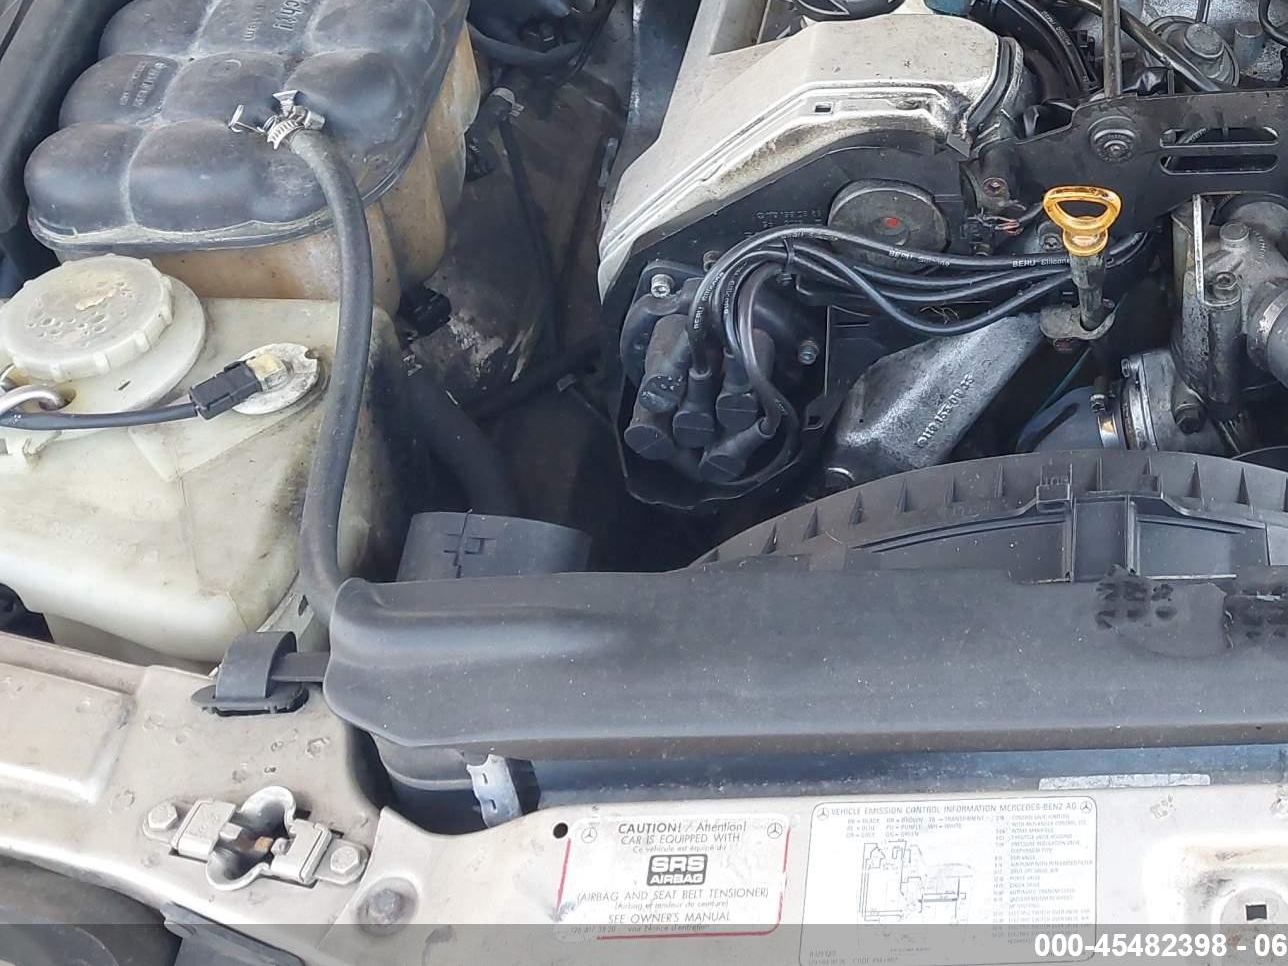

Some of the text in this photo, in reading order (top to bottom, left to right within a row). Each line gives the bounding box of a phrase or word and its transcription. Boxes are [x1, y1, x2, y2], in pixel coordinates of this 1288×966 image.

[1012, 259, 1036, 268] BERU
[832, 808, 860, 816] VEHICLE
[865, 806, 902, 815] EMISSION
[944, 805, 996, 813] INFORMATION
[1000, 803, 1063, 812] MERCEDES-BENZ
[618, 822, 682, 834] CAUTION!
[696, 821, 747, 832] Attention!
[620, 833, 740, 845] CAR IS EQUIPPED WITH
[651, 856, 705, 872] SRS
[650, 873, 704, 884] AIRBAG
[577, 887, 769, 906] (AIRBAG AND SEAT BELT TENSIONER)
[609, 912, 731, 924] SEE OWNER'S MANUAL
